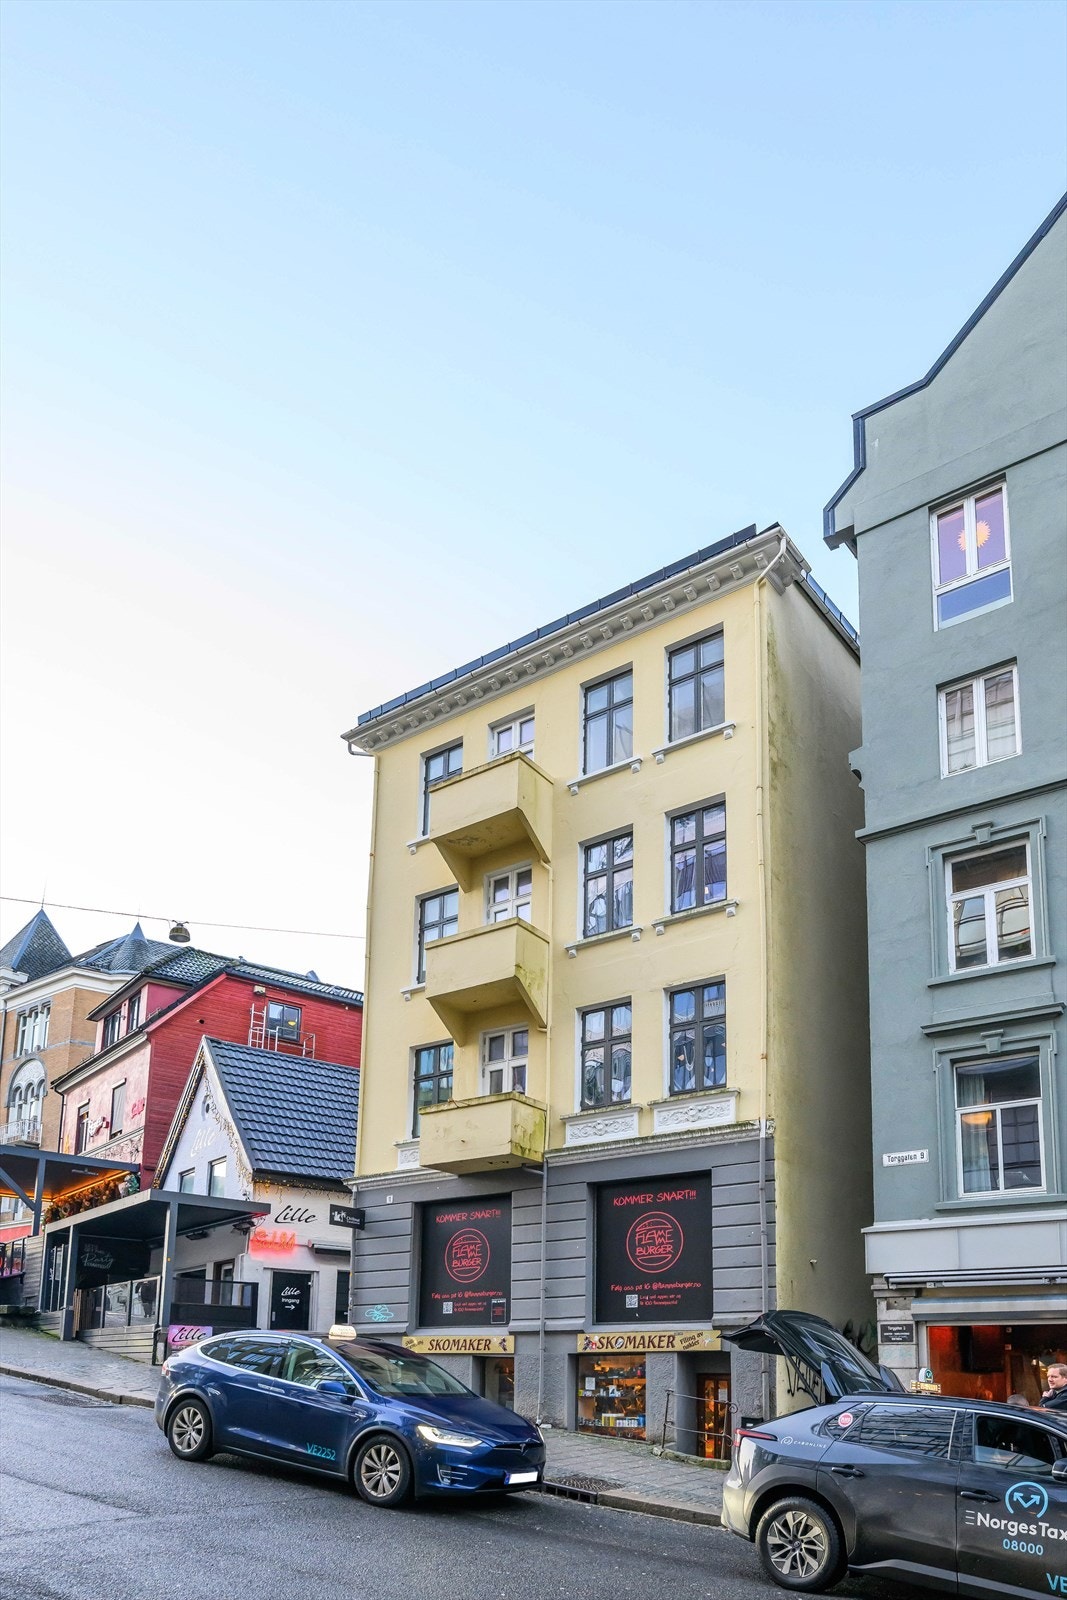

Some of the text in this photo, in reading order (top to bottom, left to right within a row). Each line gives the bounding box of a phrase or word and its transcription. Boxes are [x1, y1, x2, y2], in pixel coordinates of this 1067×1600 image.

[887, 1154, 918, 1163] Torggaten
[613, 1189, 697, 1206] KOMMER SNART!!!
[274, 1205, 318, 1224] Lille
[436, 1212, 467, 1223] KOMMER
[636, 1244, 674, 1256] BURGER
[452, 1257, 482, 1268] BURGER
[281, 1286, 301, 1296] Lille
[172, 1326, 206, 1342] Lille
[428, 1338, 491, 1351] SKOMAKER
[597, 1334, 676, 1350] SKOMAKER
[793, 1440, 827, 1449] CABONLINE
[306, 1442, 336, 1461] VE2252
[1003, 1539, 1044, 1556] 08000
